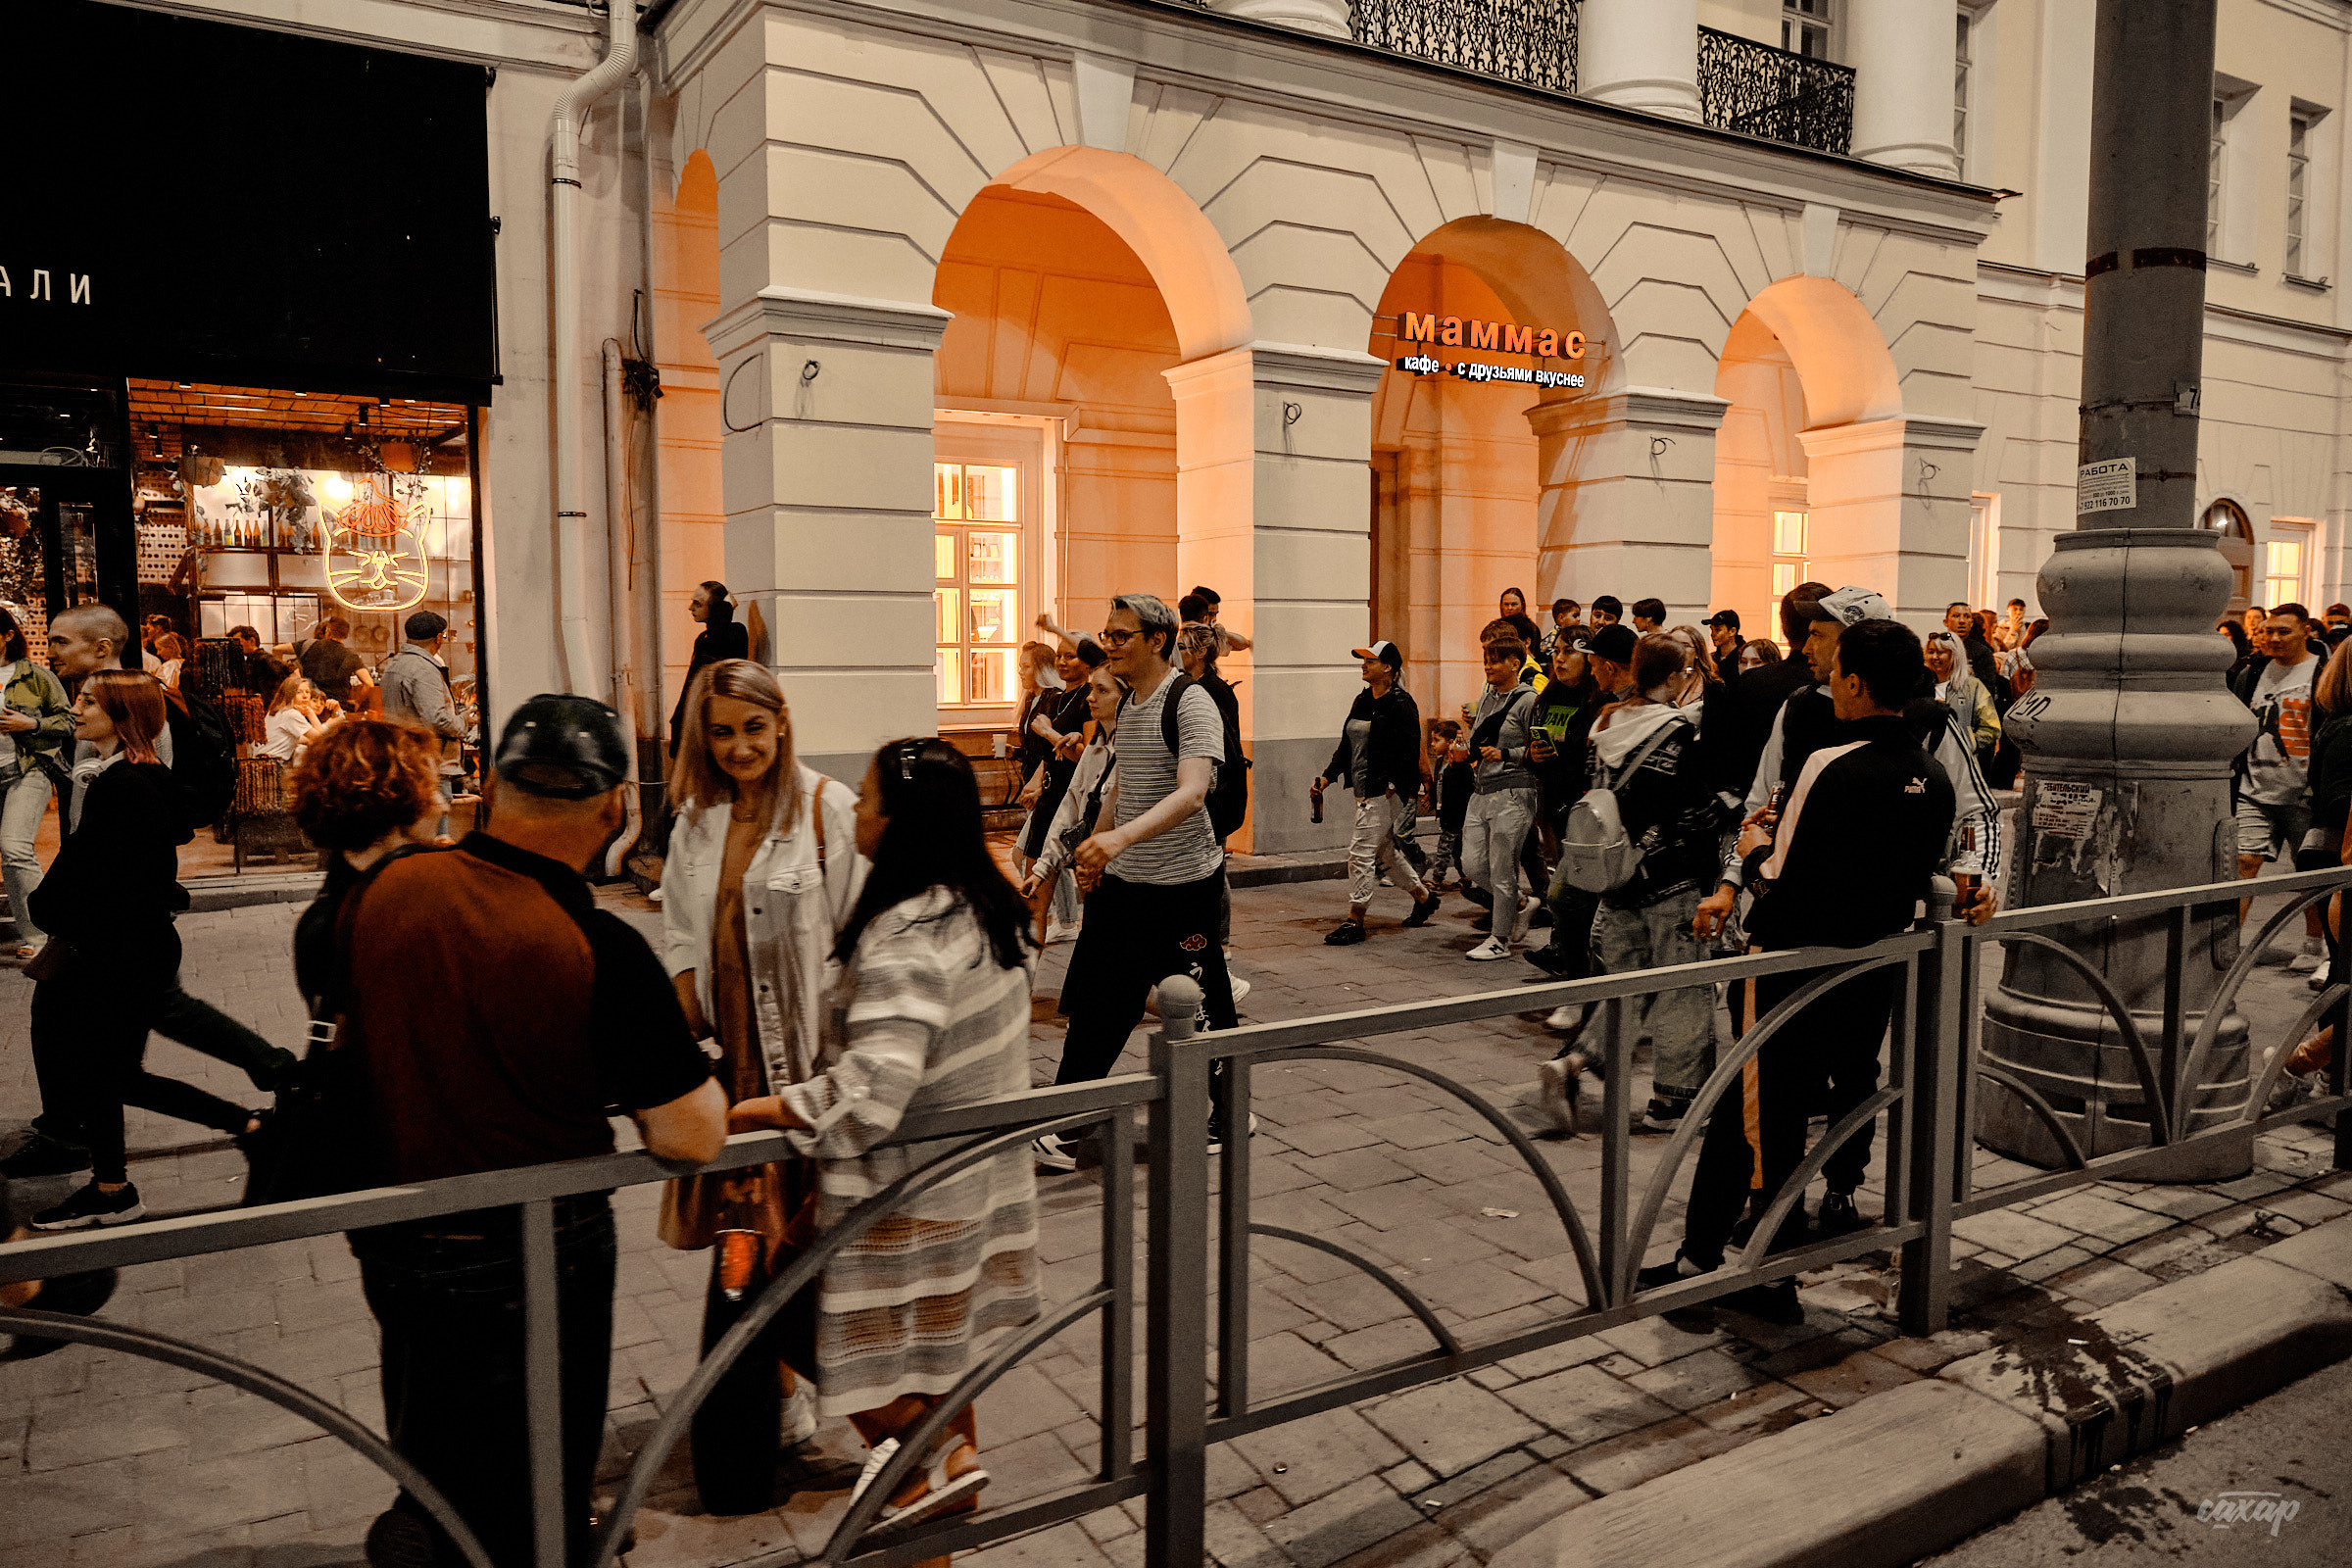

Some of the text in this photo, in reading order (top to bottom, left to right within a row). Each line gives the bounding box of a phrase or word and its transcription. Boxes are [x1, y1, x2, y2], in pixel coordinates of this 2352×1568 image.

[1404, 354, 1585, 388] кафе с друзьями вкуснее
[2080, 463, 2129, 478] РАБОТА
[2083, 500, 2094, 510] 922
[2095, 498, 2107, 508] 116
[2109, 497, 2119, 506] 70
[2121, 496, 2131, 505] 70
